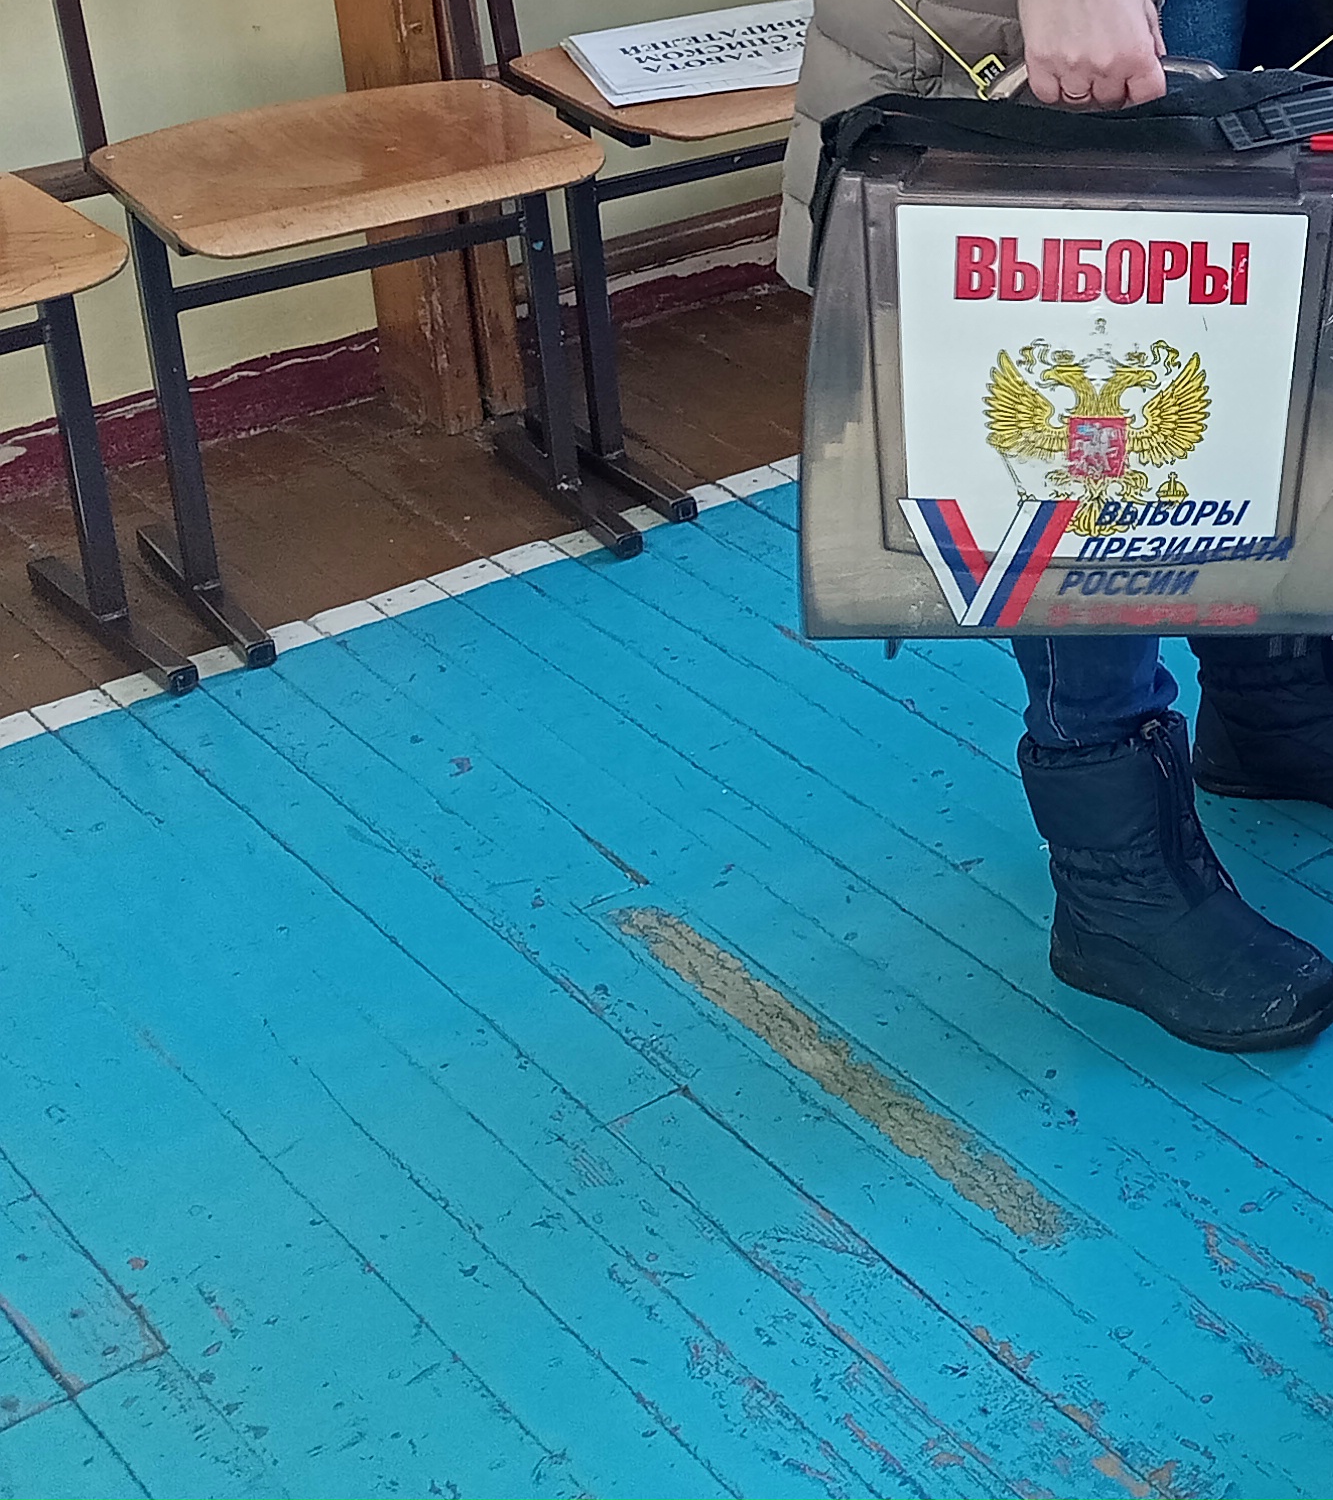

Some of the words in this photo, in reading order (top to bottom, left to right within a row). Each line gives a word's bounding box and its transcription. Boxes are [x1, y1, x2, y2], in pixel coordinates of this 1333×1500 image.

[634, 34, 789, 63] СПИСКОМ
[643, 50, 763, 74] РАБОТА
[954, 235, 1251, 305] ВЫБОРЫ
[1095, 500, 1251, 527] ВЫБОРЫ
[1075, 536, 1294, 563] ПРЕЗИДЕНТА
[1058, 569, 1200, 596] РОССИИ
